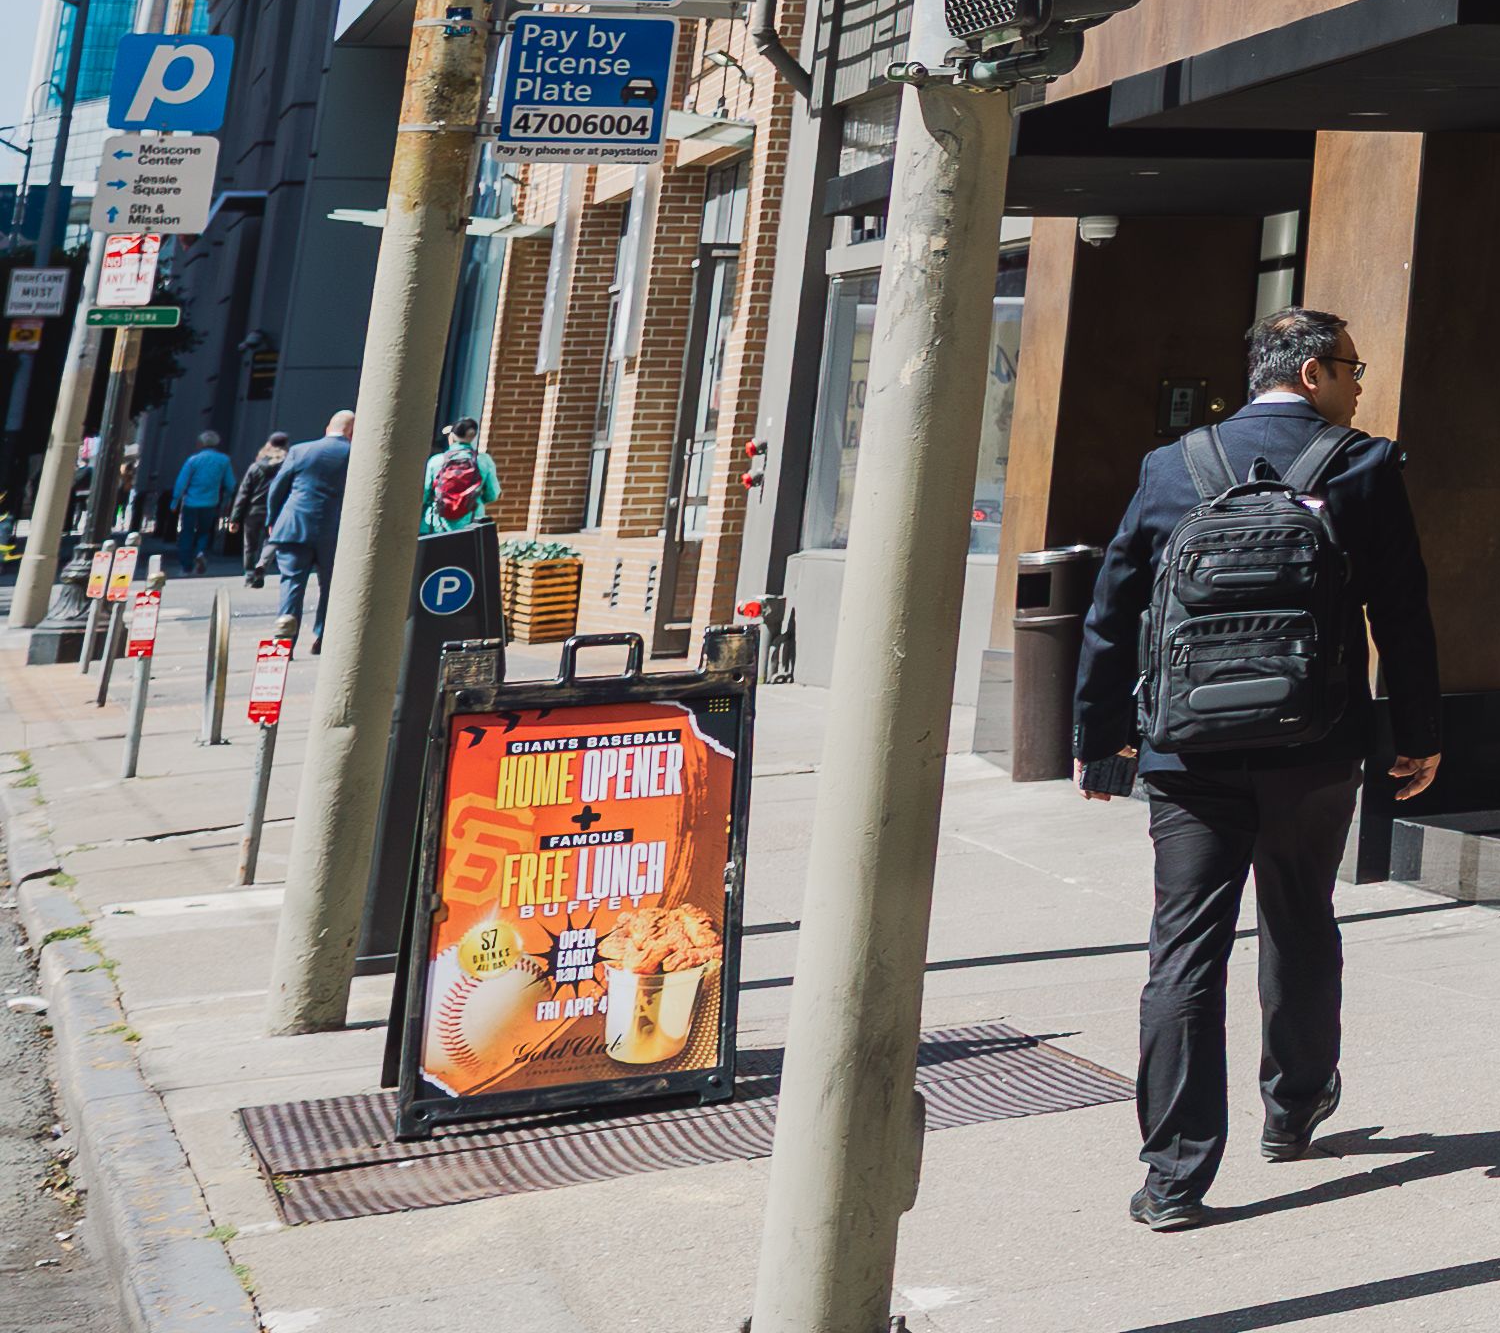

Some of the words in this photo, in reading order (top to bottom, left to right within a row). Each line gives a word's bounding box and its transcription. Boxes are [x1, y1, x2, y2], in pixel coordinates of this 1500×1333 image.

[522, 24, 578, 53] Pay
[587, 24, 626, 55] by
[519, 50, 631, 76] License
[514, 77, 592, 102] Plate
[513, 113, 649, 136] 47006004
[140, 144, 201, 155] Moscone
[496, 145, 520, 157] Pay
[519, 145, 533, 157] by
[535, 146, 570, 157] phone
[573, 148, 586, 156] or
[587, 147, 599, 156] at
[601, 147, 658, 157] paystation
[137, 155, 185, 165] Center
[134, 175, 178, 184] Jessie
[132, 185, 182, 197] Square
[130, 204, 151, 214] 5th
[155, 204, 165, 214] &
[128, 215, 181, 224] Mission
[106, 273, 125, 285] ANY
[22, 287, 54, 299] MUST
[436, 576, 461, 606] P
[511, 738, 579, 754] GIANTS
[587, 731, 677, 748] BASEBALL
[496, 752, 577, 810] HOME
[580, 744, 684, 802] OPENER
[549, 831, 625, 848] FAMOUS
[500, 851, 573, 909] FREE
[576, 841, 667, 901] LUNCH
[519, 895, 644, 919] BUFFET
[559, 929, 597, 950] OPEN
[473, 948, 511, 964] DRINKS
[557, 948, 596, 968] EARLY
[536, 1000, 561, 1022] FRI
[564, 997, 595, 1018] APR
[597, 995, 608, 1014] 4
[513, 1038, 570, 1063] Gold
